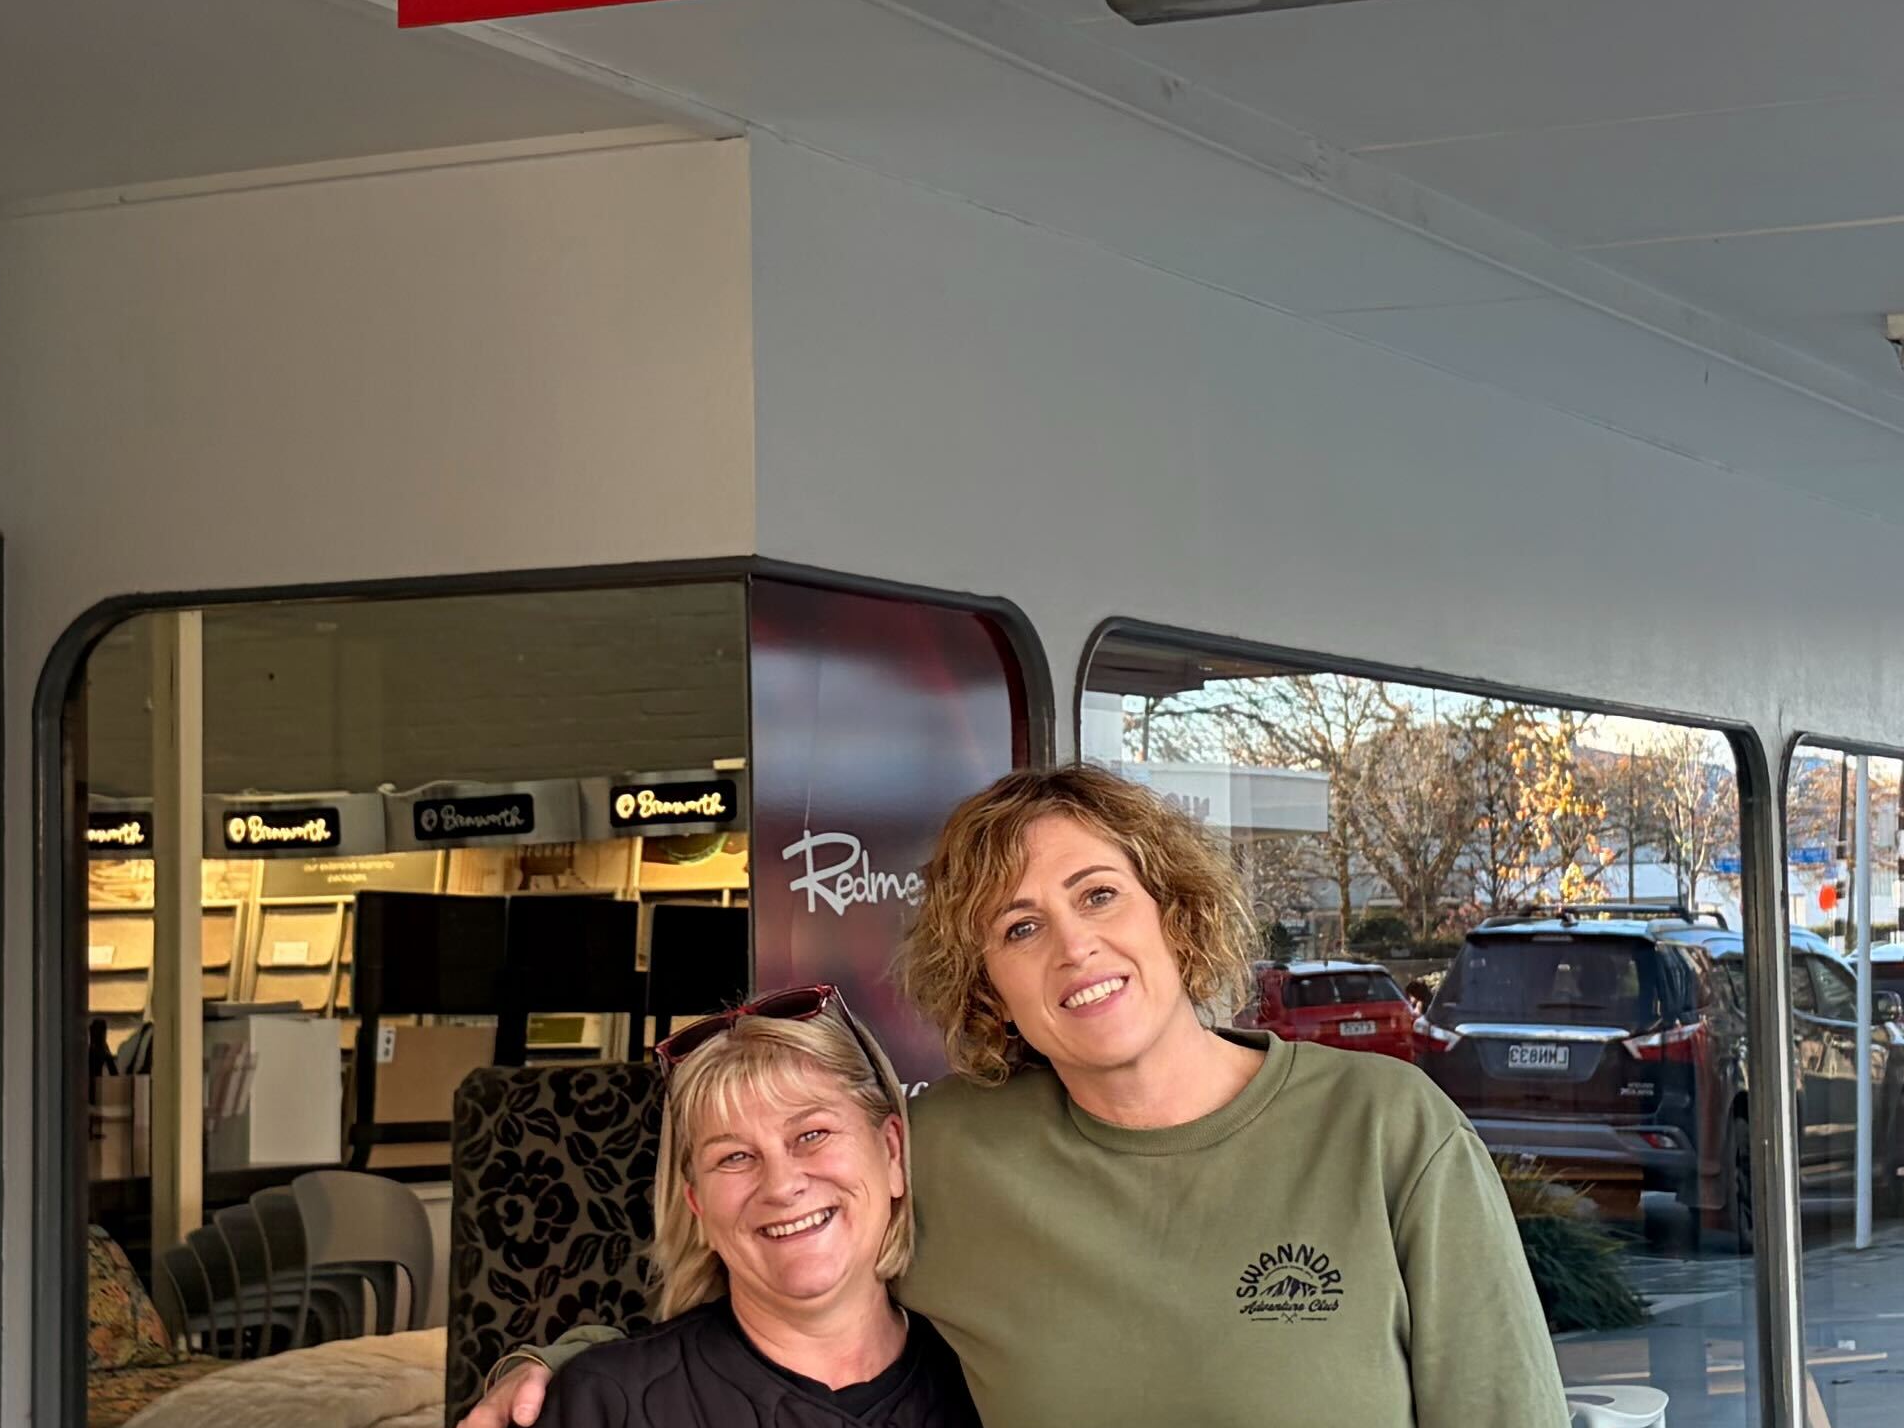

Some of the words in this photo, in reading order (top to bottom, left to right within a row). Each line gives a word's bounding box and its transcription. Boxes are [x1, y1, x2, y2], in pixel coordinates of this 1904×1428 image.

[1236, 1243, 1344, 1298] SWANNDRI
[1239, 1299, 1305, 1315] Adventure
[1308, 1298, 1340, 1313] Club
